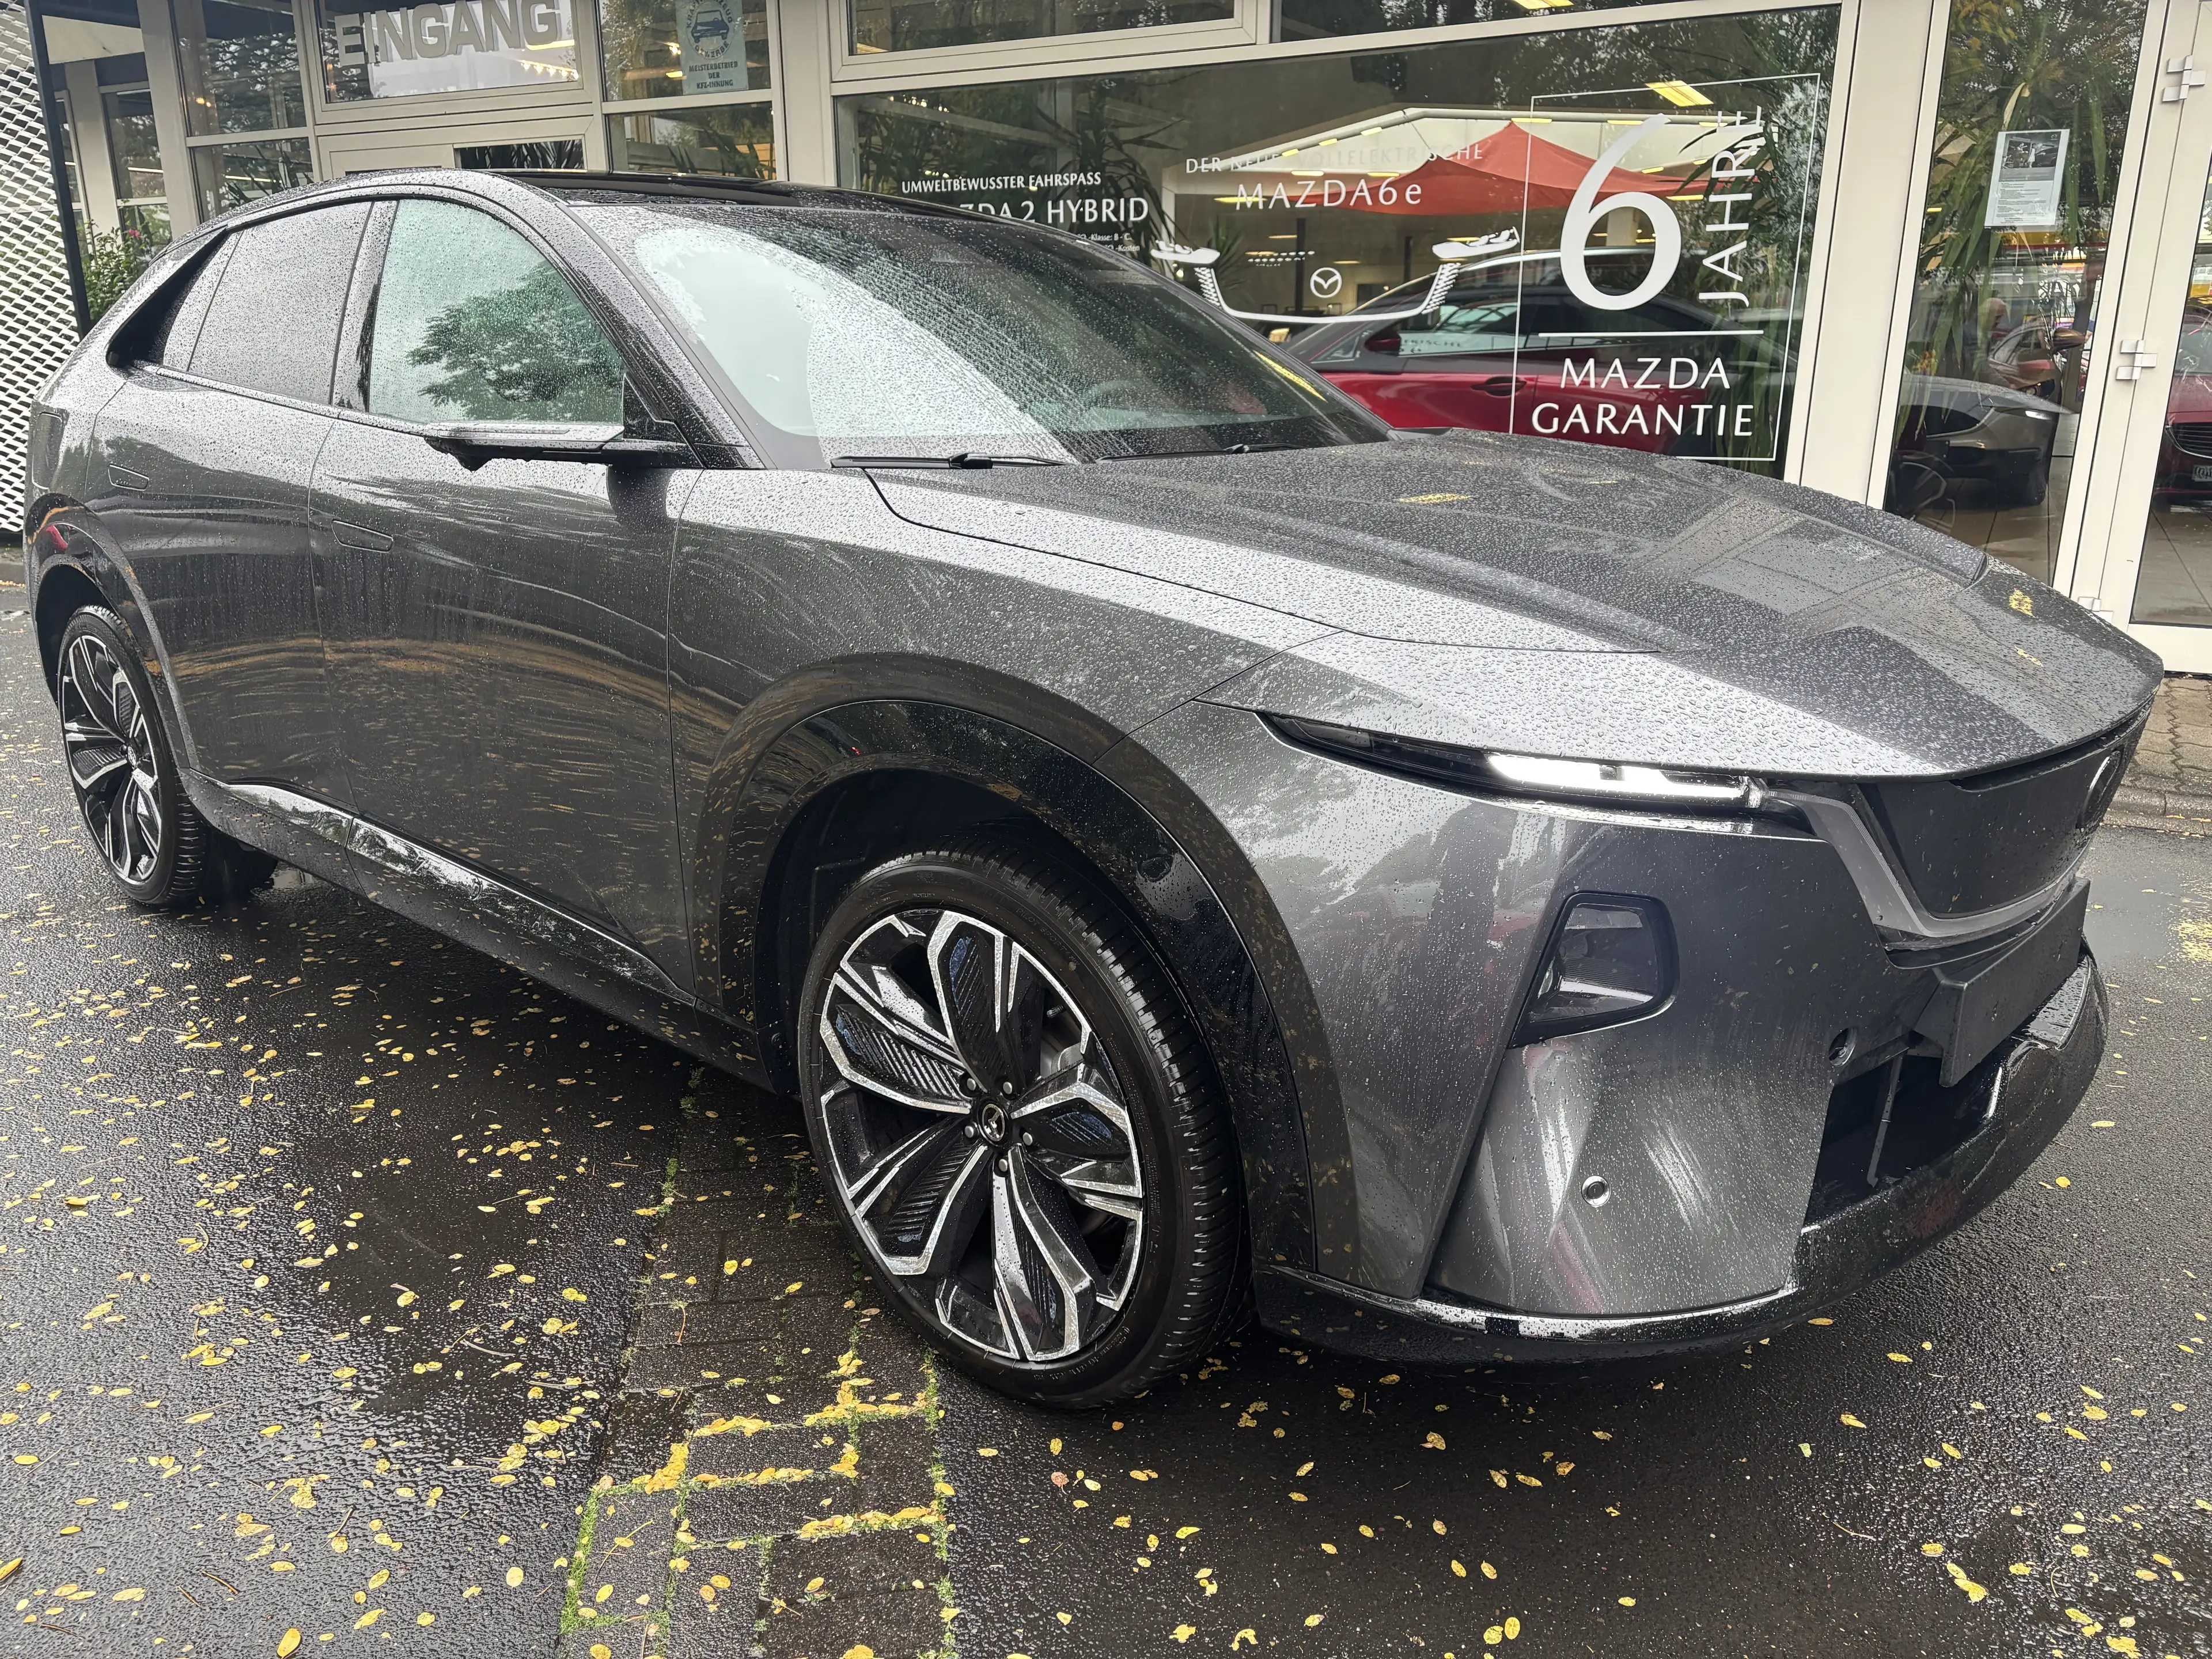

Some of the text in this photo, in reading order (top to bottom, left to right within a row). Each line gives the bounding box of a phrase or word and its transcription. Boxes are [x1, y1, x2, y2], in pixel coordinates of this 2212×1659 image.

[335, 0, 559, 67] EINGANG
[689, 60, 738, 72] MEISTERBETRIEB
[708, 71, 720, 79] DER
[696, 79, 733, 89] KFZ-INNUNG
[1185, 157, 1222, 174] DER
[902, 171, 1102, 194] UMWELTBEWUSSTER FAHRSPASS
[1235, 176, 1423, 211] MAZDA6e
[1047, 196, 1149, 224] HYBRID
[1560, 112, 1682, 311] 6
[1698, 105, 1765, 307] JAHRE
[1560, 357, 1731, 389] MAZDA
[1532, 402, 1754, 437] GARANTIE
